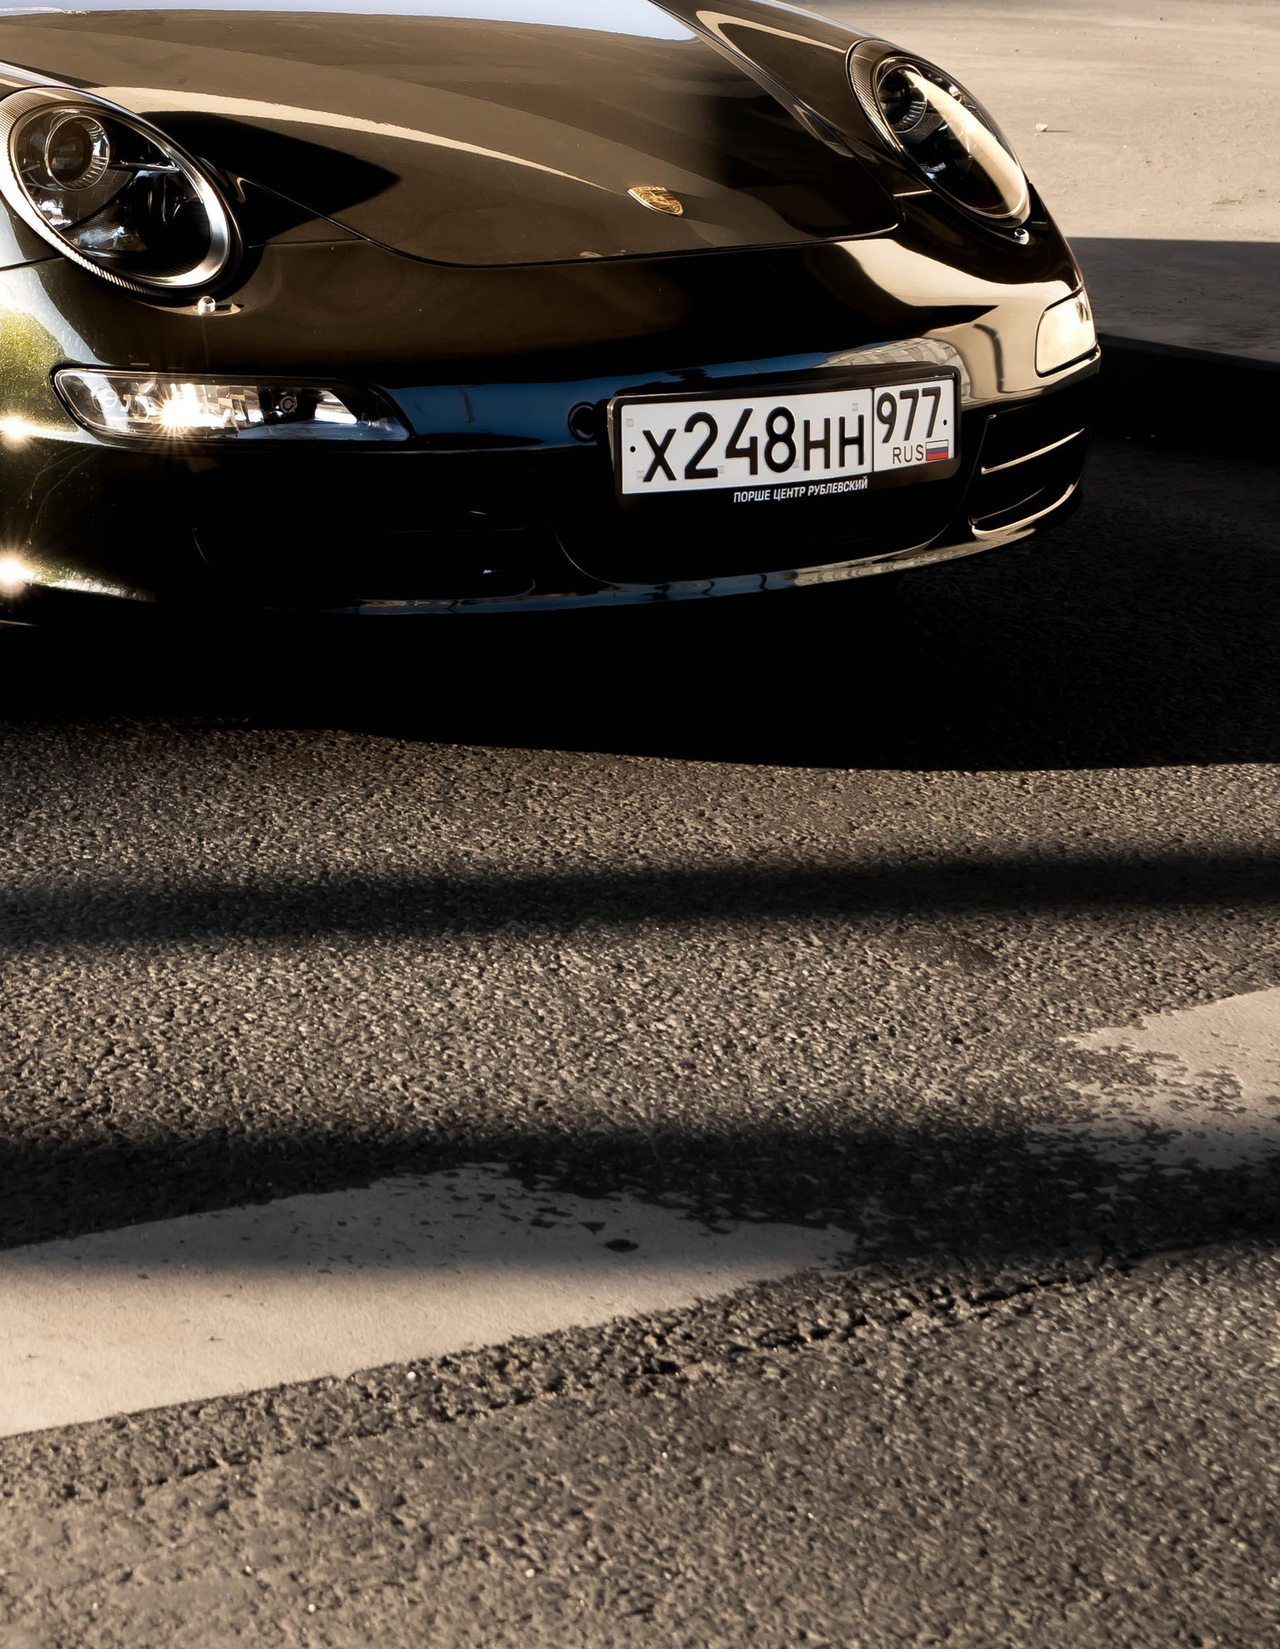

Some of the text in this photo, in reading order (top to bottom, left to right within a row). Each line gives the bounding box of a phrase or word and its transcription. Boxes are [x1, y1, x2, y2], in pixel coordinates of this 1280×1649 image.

[876, 386, 942, 444] 977
[892, 444, 924, 464] RUS
[733, 476, 869, 503] ПОРШЕ ЦЕНТР РУБЛЕВСКИЙ
